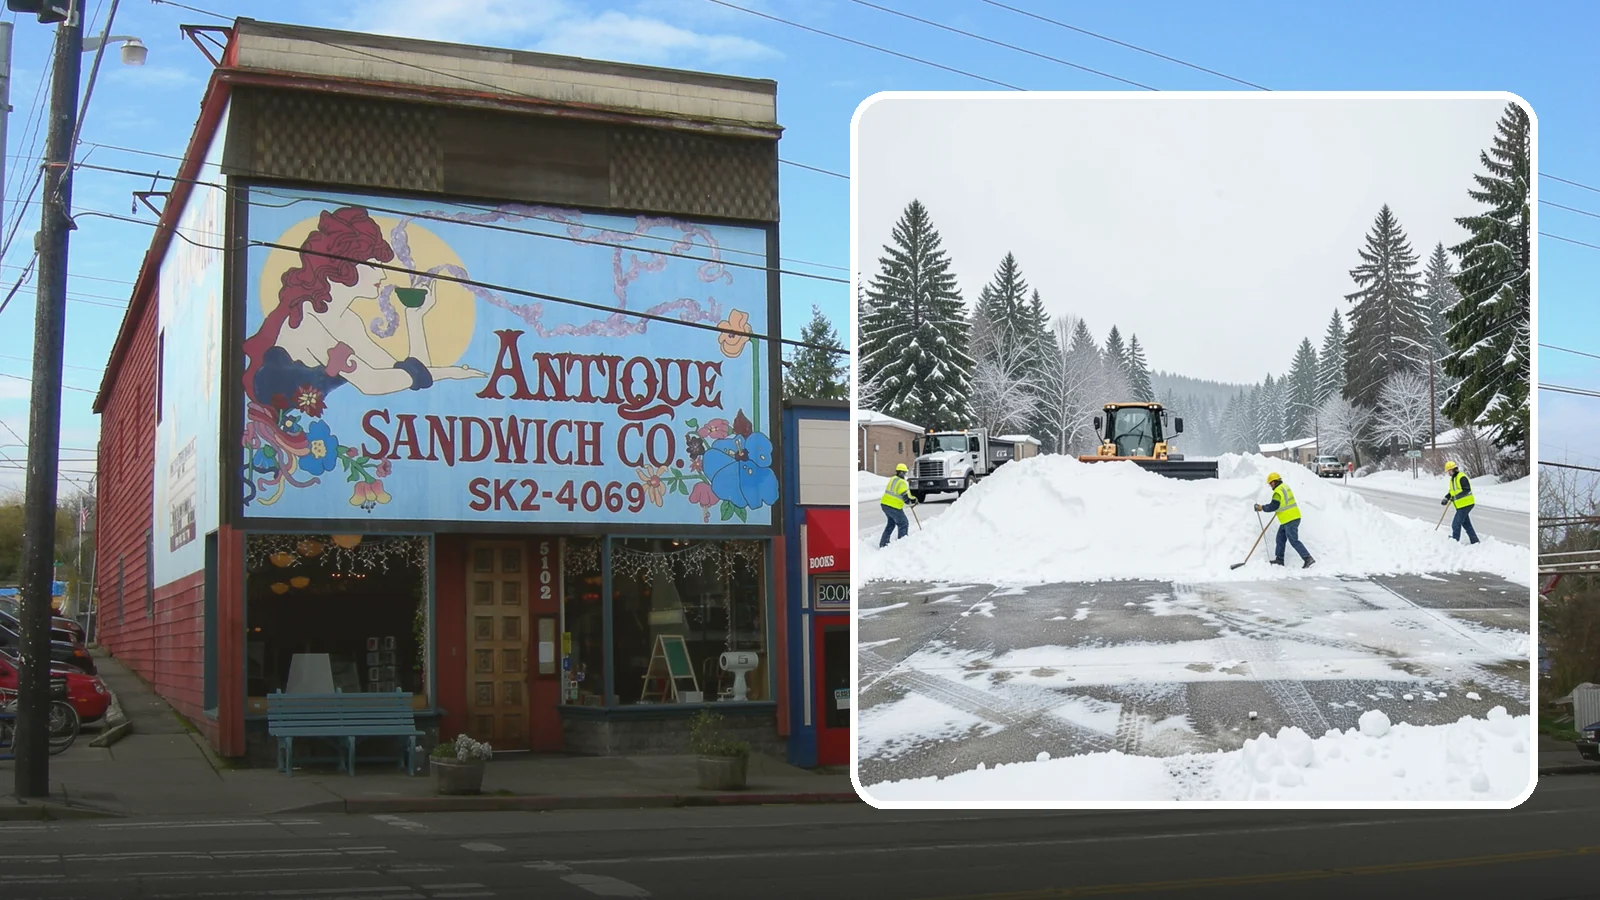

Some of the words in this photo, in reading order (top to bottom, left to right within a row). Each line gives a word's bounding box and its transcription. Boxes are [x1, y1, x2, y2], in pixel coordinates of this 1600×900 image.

[476, 329, 724, 421] ANTIQUE
[361, 408, 605, 467] SANDWICH
[617, 422, 685, 469] CO.
[467, 476, 645, 513] SK2-4069
[539, 541, 552, 600] 5102
[809, 555, 835, 569] BOOKS
